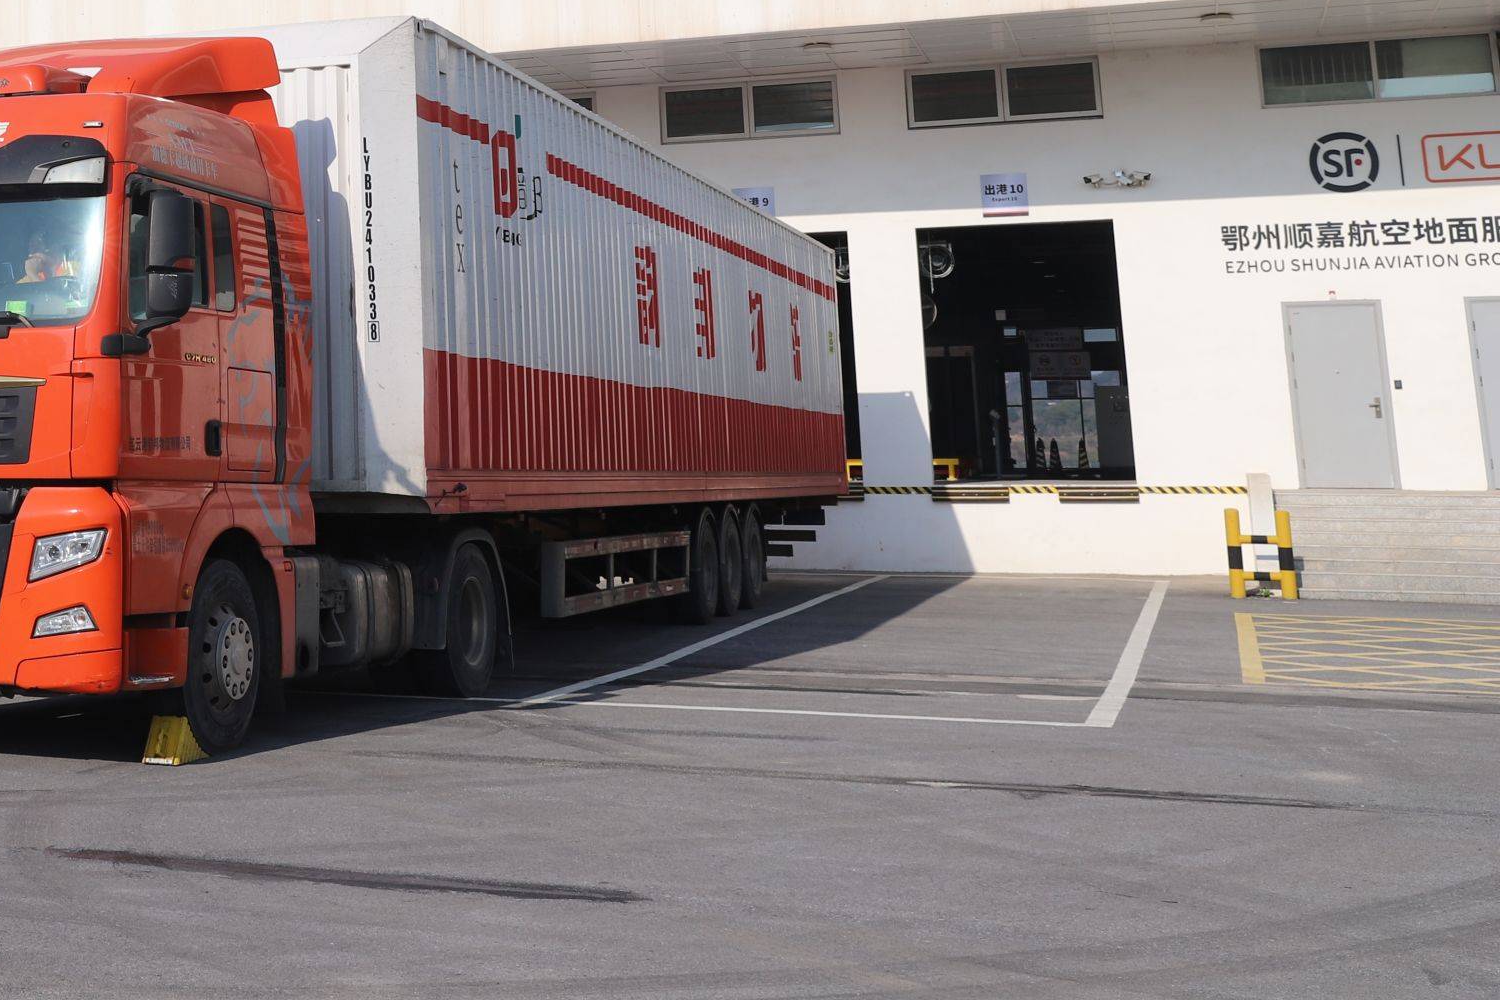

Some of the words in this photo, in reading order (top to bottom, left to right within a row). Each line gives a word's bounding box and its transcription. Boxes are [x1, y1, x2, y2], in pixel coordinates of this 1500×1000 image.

[1323, 149, 1364, 178] SF
[984, 184, 1007, 195] 出港
[1010, 184, 1024, 194] 10
[1225, 259, 1286, 274] EZHOU
[1291, 256, 1370, 273] SHUNJIA
[1374, 253, 1460, 270] AVIATION
